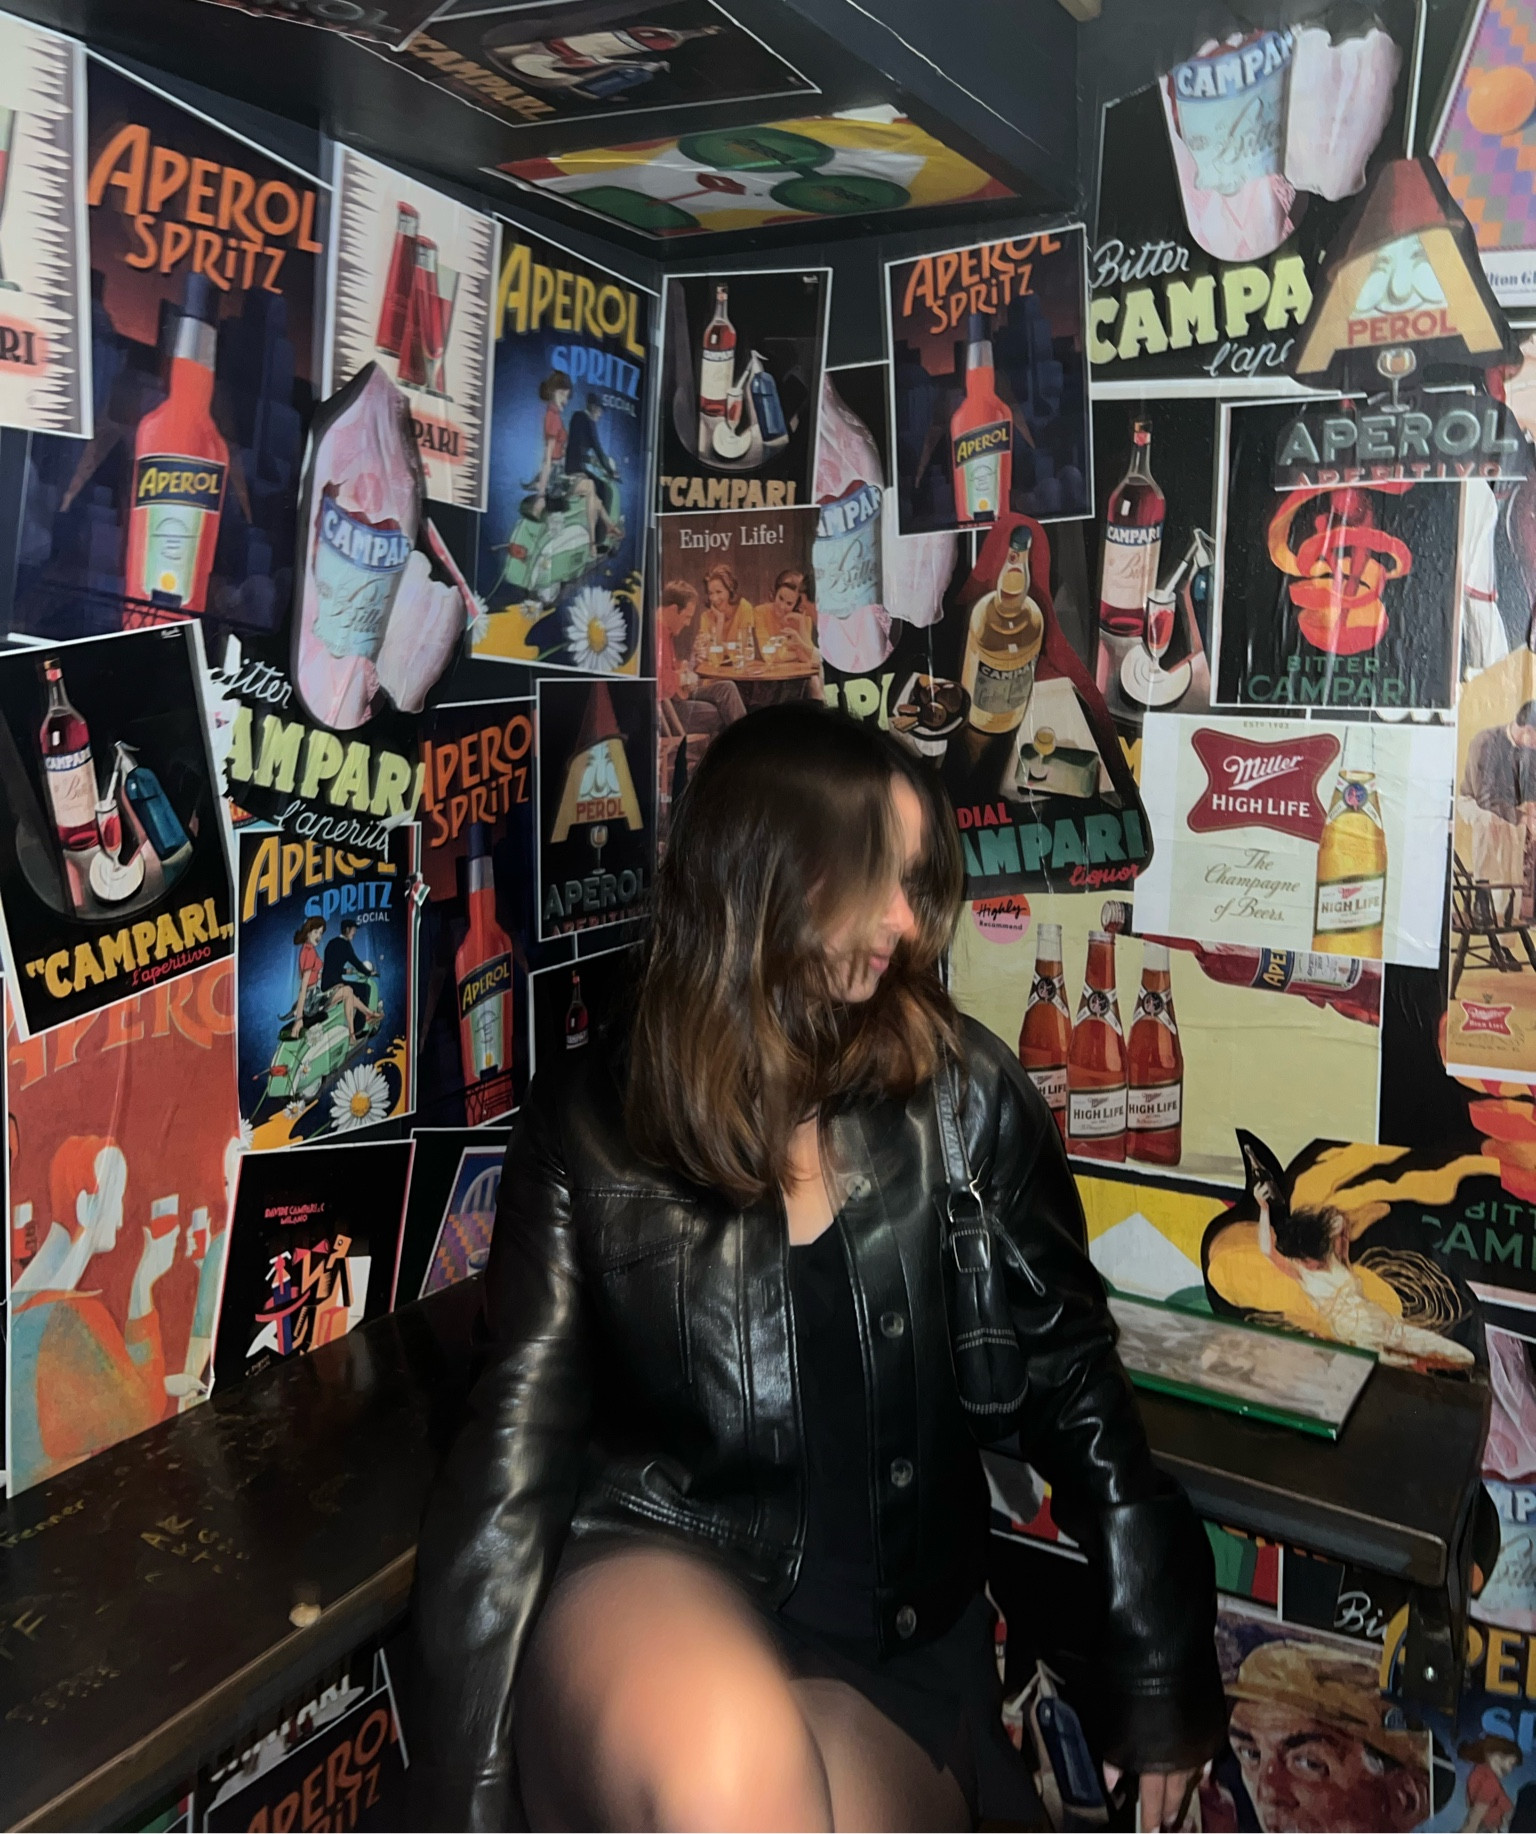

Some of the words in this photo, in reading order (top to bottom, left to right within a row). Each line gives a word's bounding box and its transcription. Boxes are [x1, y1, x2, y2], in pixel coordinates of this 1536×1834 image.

[86, 123, 322, 253] APEROL
[1088, 240, 1190, 289] Bitter
[495, 243, 645, 358] APEROL
[956, 426, 1010, 463] APEROL
[1278, 409, 1519, 466] APEROL
[138, 467, 221, 498] APEROL
[679, 526, 732, 553] Enjoy
[740, 524, 785, 546] Life!
[1286, 655, 1381, 673] BITTER
[1247, 674, 1418, 707] CAMPARI
[1223, 755, 1304, 790] Miller
[1212, 794, 1263, 816] HIGH
[1267, 797, 1312, 818] LIFE
[1069, 863, 1141, 888] liquor
[1234, 848, 1275, 872] The
[543, 867, 650, 920] APEROL
[1204, 863, 1301, 898] Champagne
[356, 911, 391, 925] SOCIAL
[1209, 901, 1231, 923] of
[1262, 950, 1289, 988] APE
[462, 962, 510, 1011] APEROL
[1073, 1108, 1101, 1120] HIGH
[1103, 1105, 1124, 1119] LIFE
[1128, 1104, 1154, 1114] HIGH
[1157, 1100, 1177, 1114] LIFE
